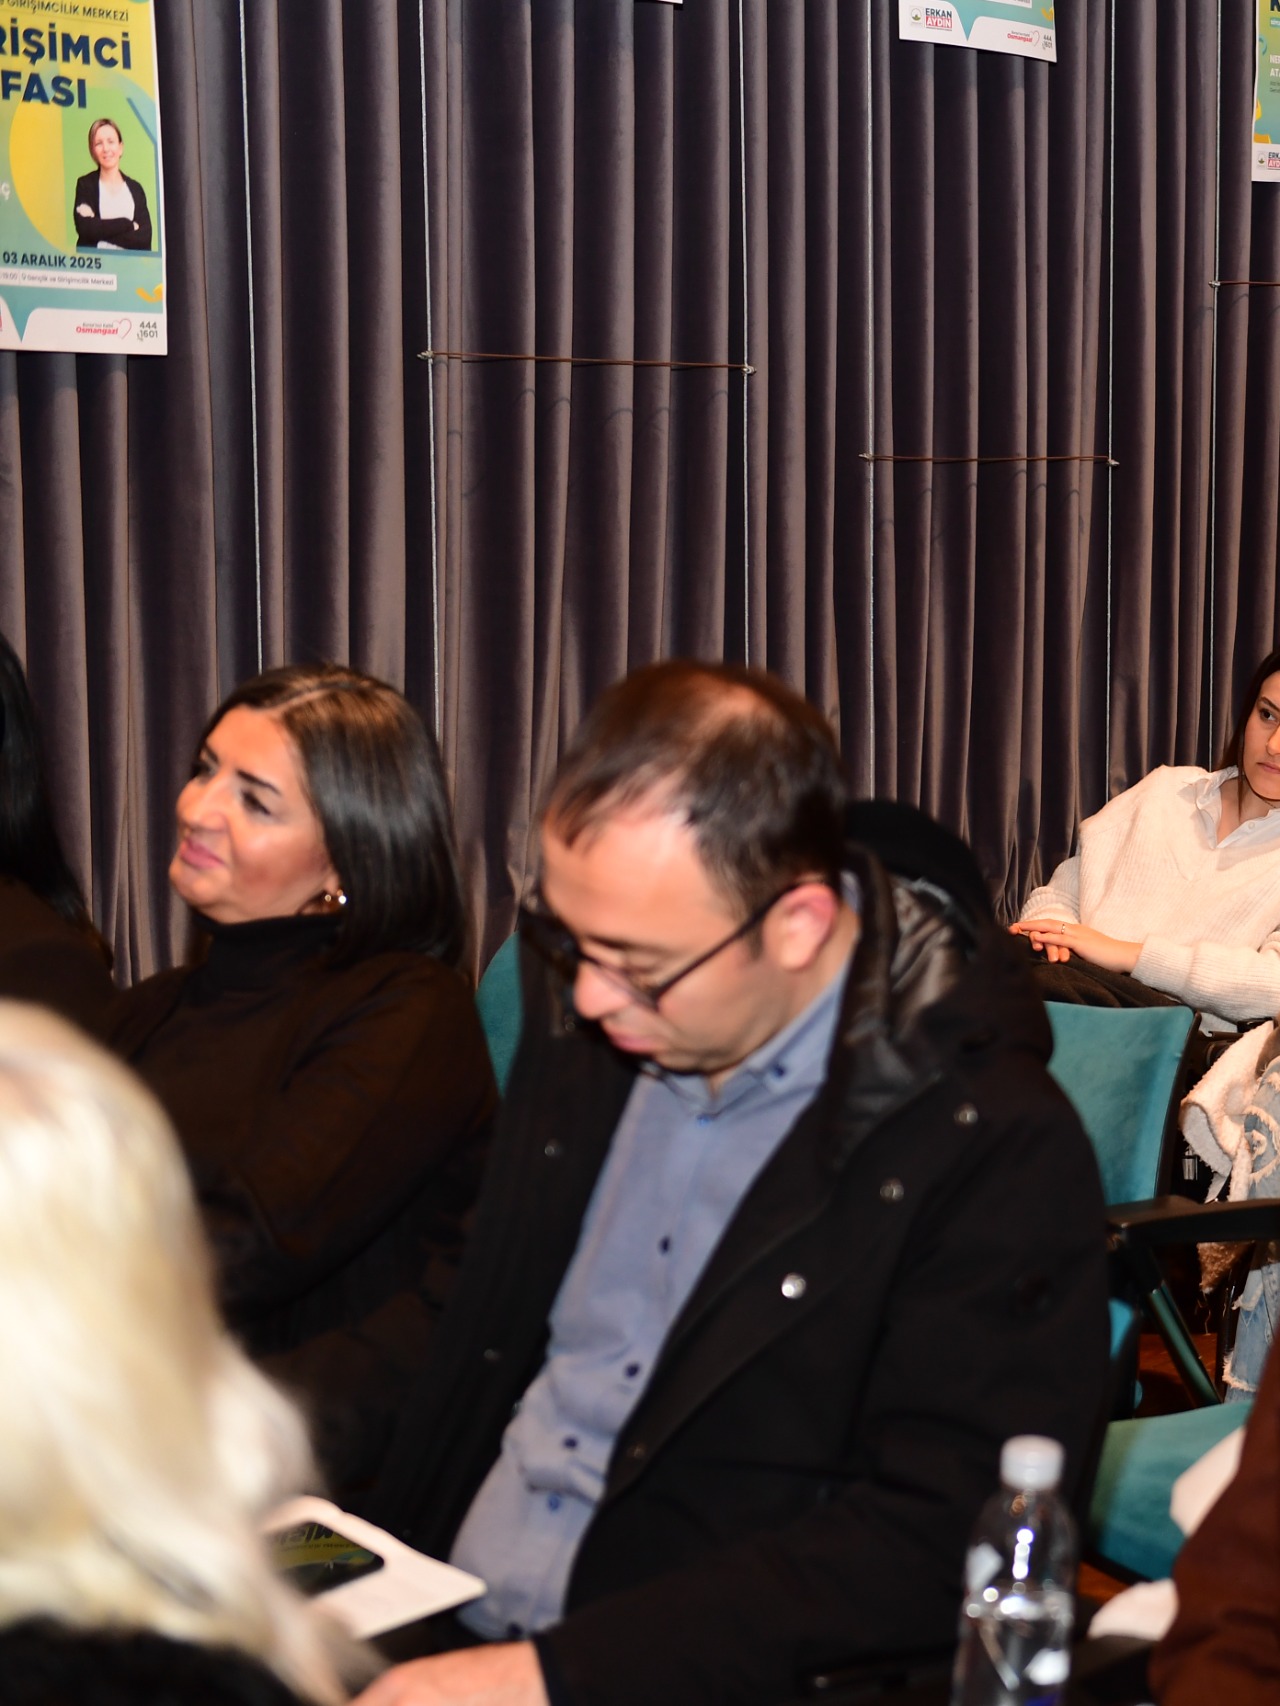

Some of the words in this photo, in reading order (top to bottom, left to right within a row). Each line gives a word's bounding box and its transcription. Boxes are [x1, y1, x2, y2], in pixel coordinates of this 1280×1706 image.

[83, 6, 129, 21] MERKEZİ
[925, 8, 953, 18] ERKAN
[926, 17, 952, 28] AYDIN
[2, 251, 18, 265] 03
[20, 253, 67, 268] ARALIK
[69, 257, 102, 270] 2025
[139, 321, 157, 329] 444
[76, 326, 118, 335] Osmangazi
[140, 329, 158, 338] 1601
